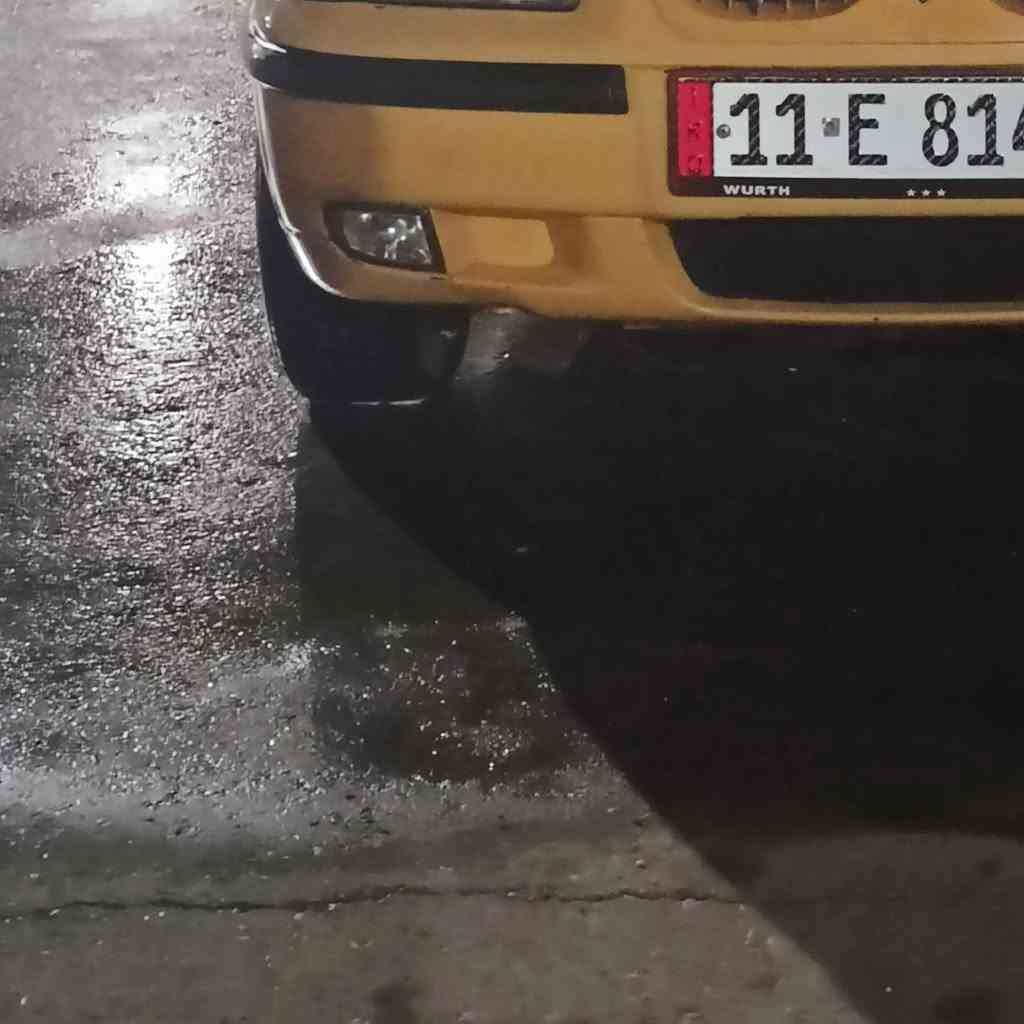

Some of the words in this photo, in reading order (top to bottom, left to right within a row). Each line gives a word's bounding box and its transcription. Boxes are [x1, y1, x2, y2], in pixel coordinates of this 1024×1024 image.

[729, 93, 814, 166] 11
[848, 93, 888, 166] E
[723, 184, 791, 196] WURTH
